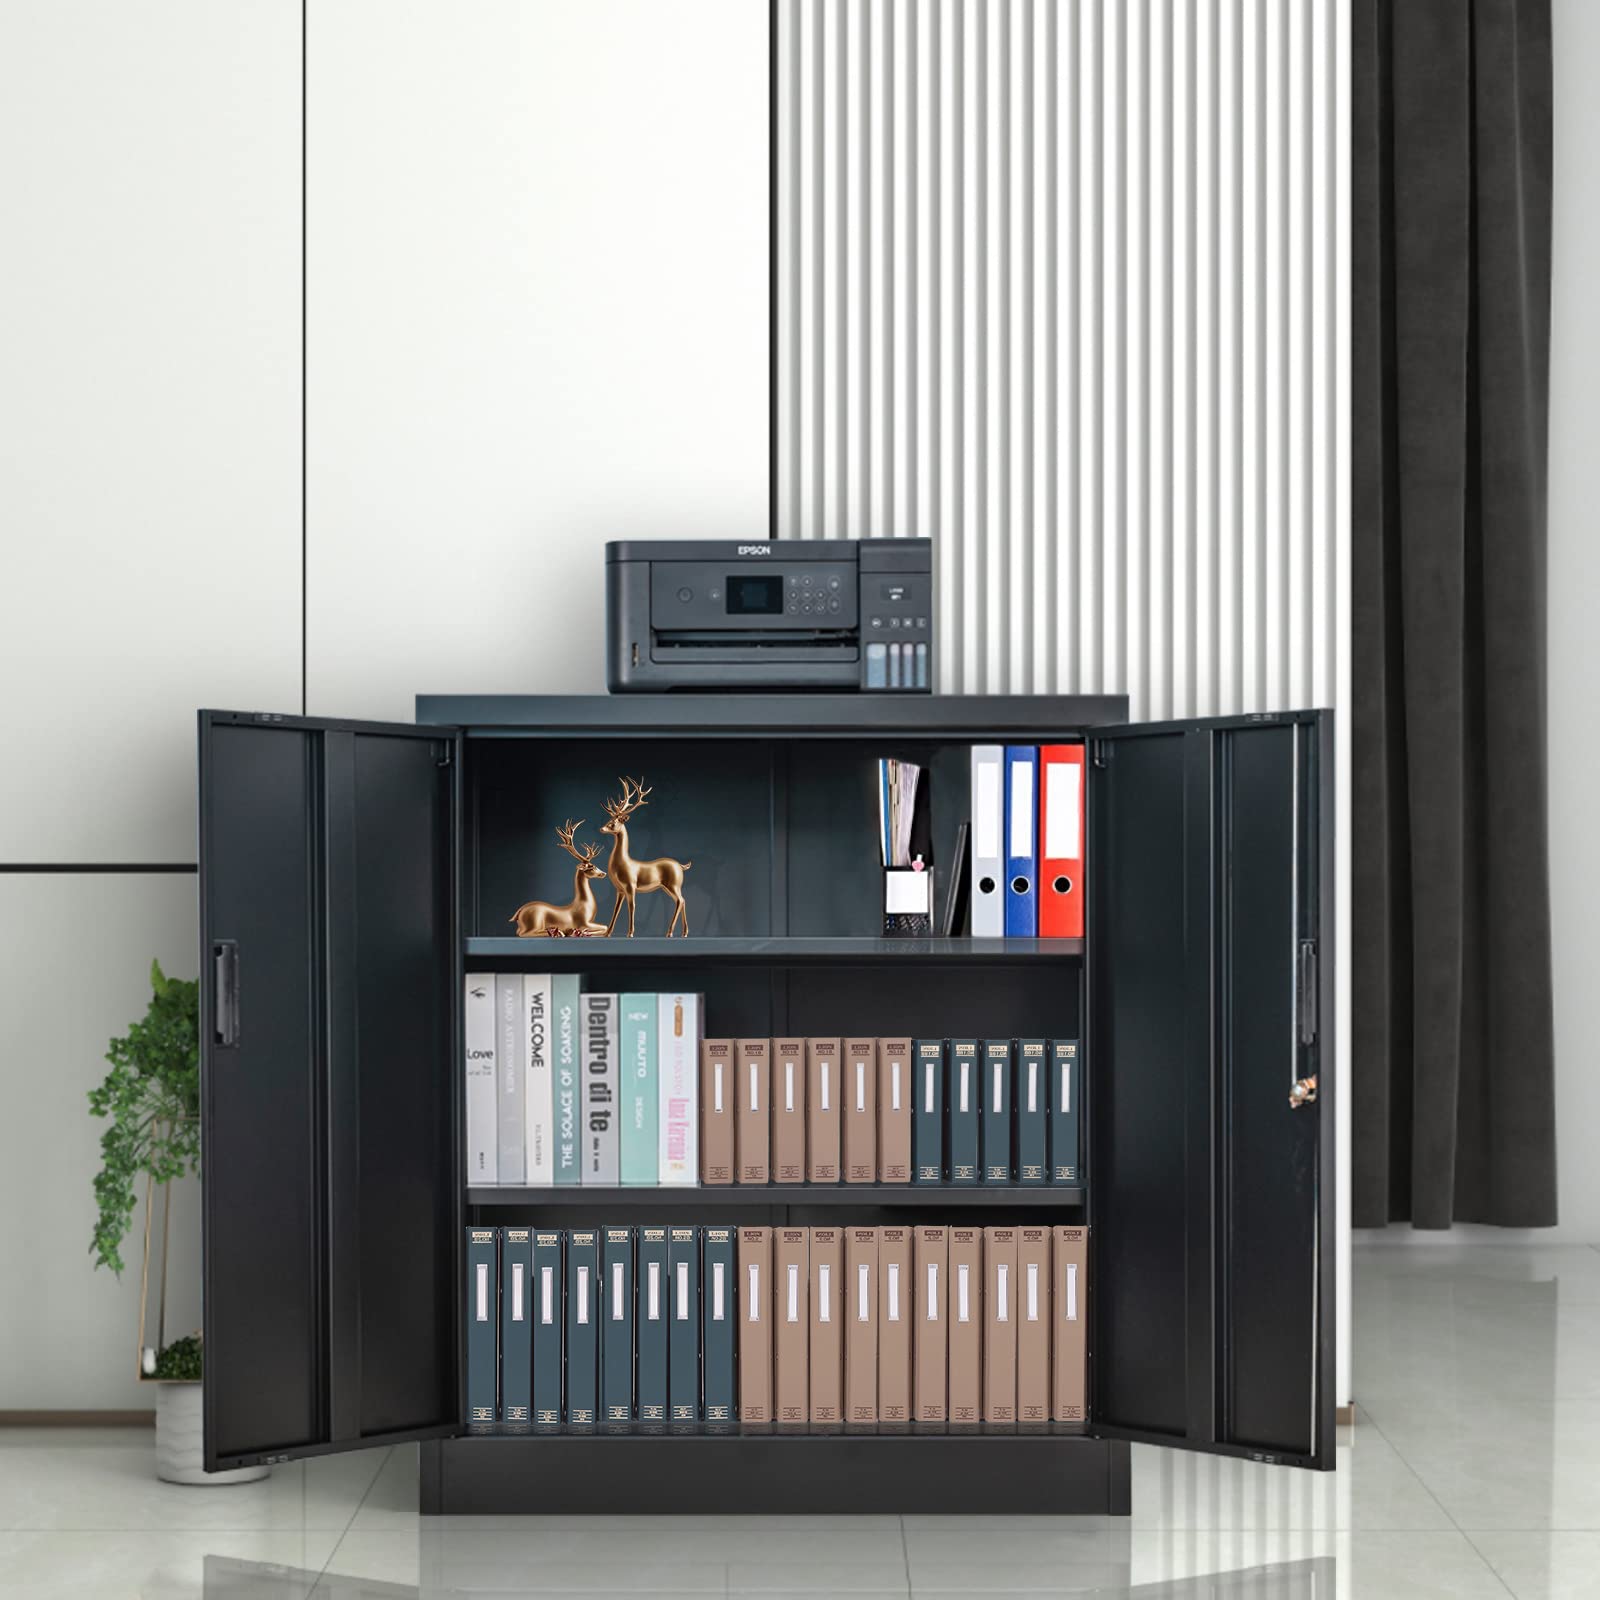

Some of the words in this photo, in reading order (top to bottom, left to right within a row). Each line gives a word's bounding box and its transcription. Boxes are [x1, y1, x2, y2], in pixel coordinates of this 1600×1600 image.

[738, 546, 771, 555] EPSON
[531, 992, 544, 1068] WELCOME
[560, 1006, 572, 1064] SOAKING
[588, 996, 611, 1075] Dentro
[467, 1049, 493, 1060] Love
[561, 1070, 573, 1086] OF
[589, 1082, 612, 1103] di
[561, 1090, 573, 1138] SOLACE
[589, 1110, 611, 1132] te
[561, 1149, 573, 1169] THE
